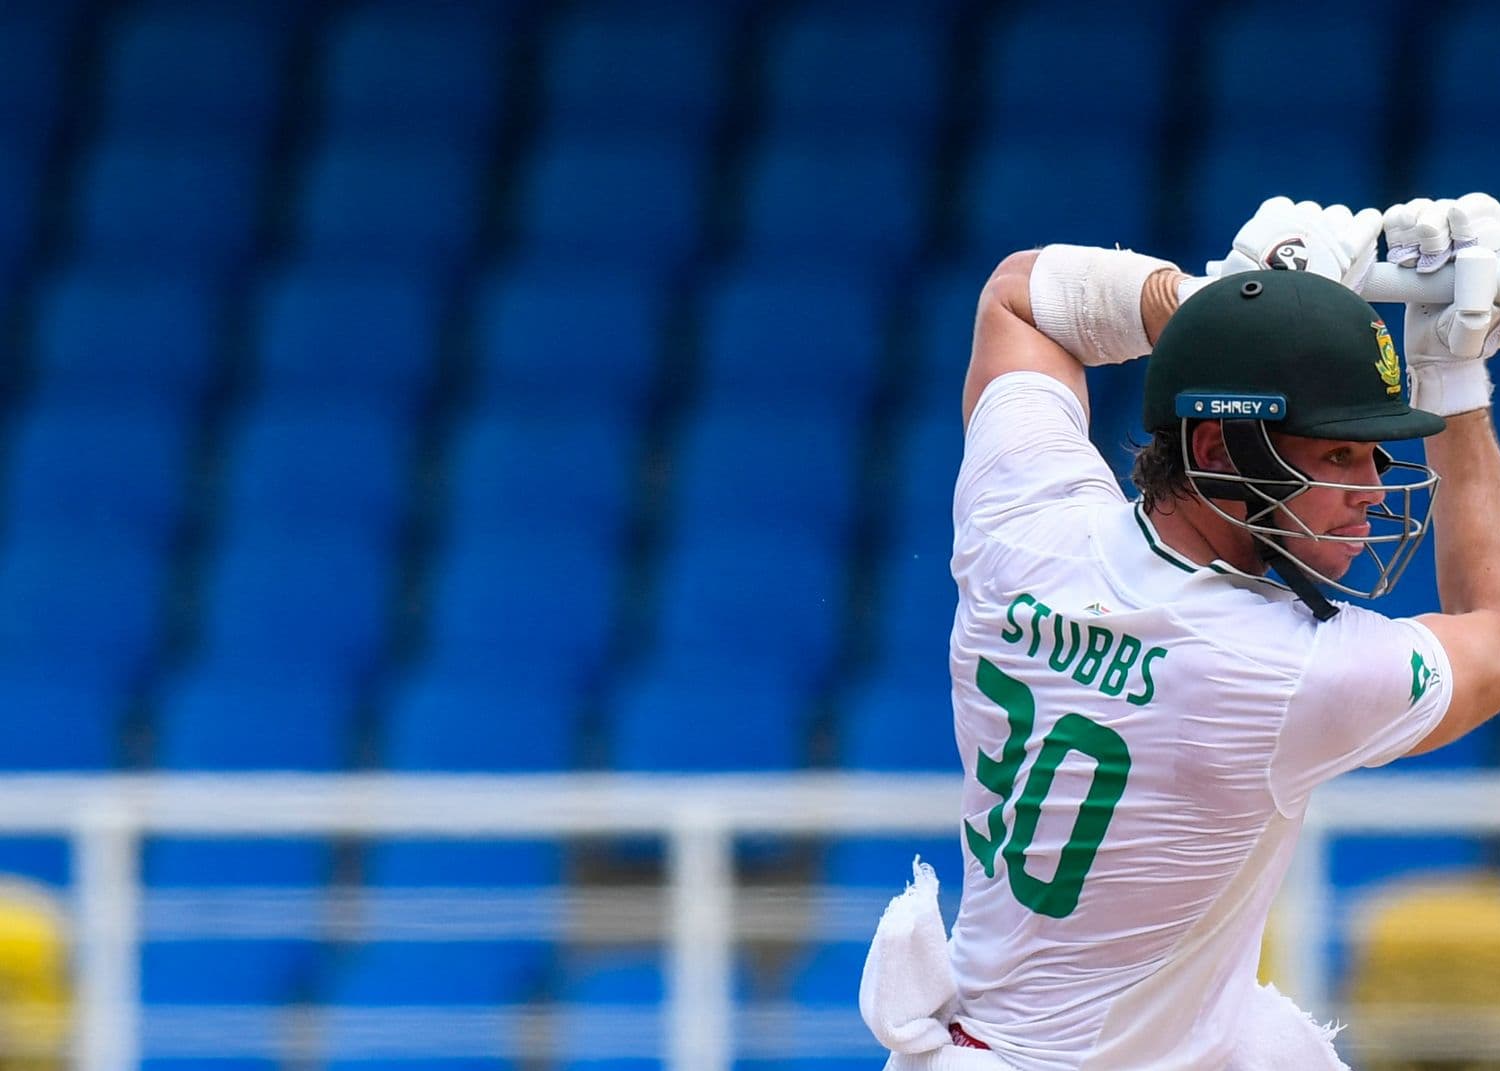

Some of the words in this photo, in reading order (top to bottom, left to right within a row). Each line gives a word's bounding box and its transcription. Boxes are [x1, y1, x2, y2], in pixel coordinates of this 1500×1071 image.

[1210, 400, 1262, 414] SHREY
[1001, 593, 1168, 706] STUBBS
[963, 655, 1132, 919] 30
